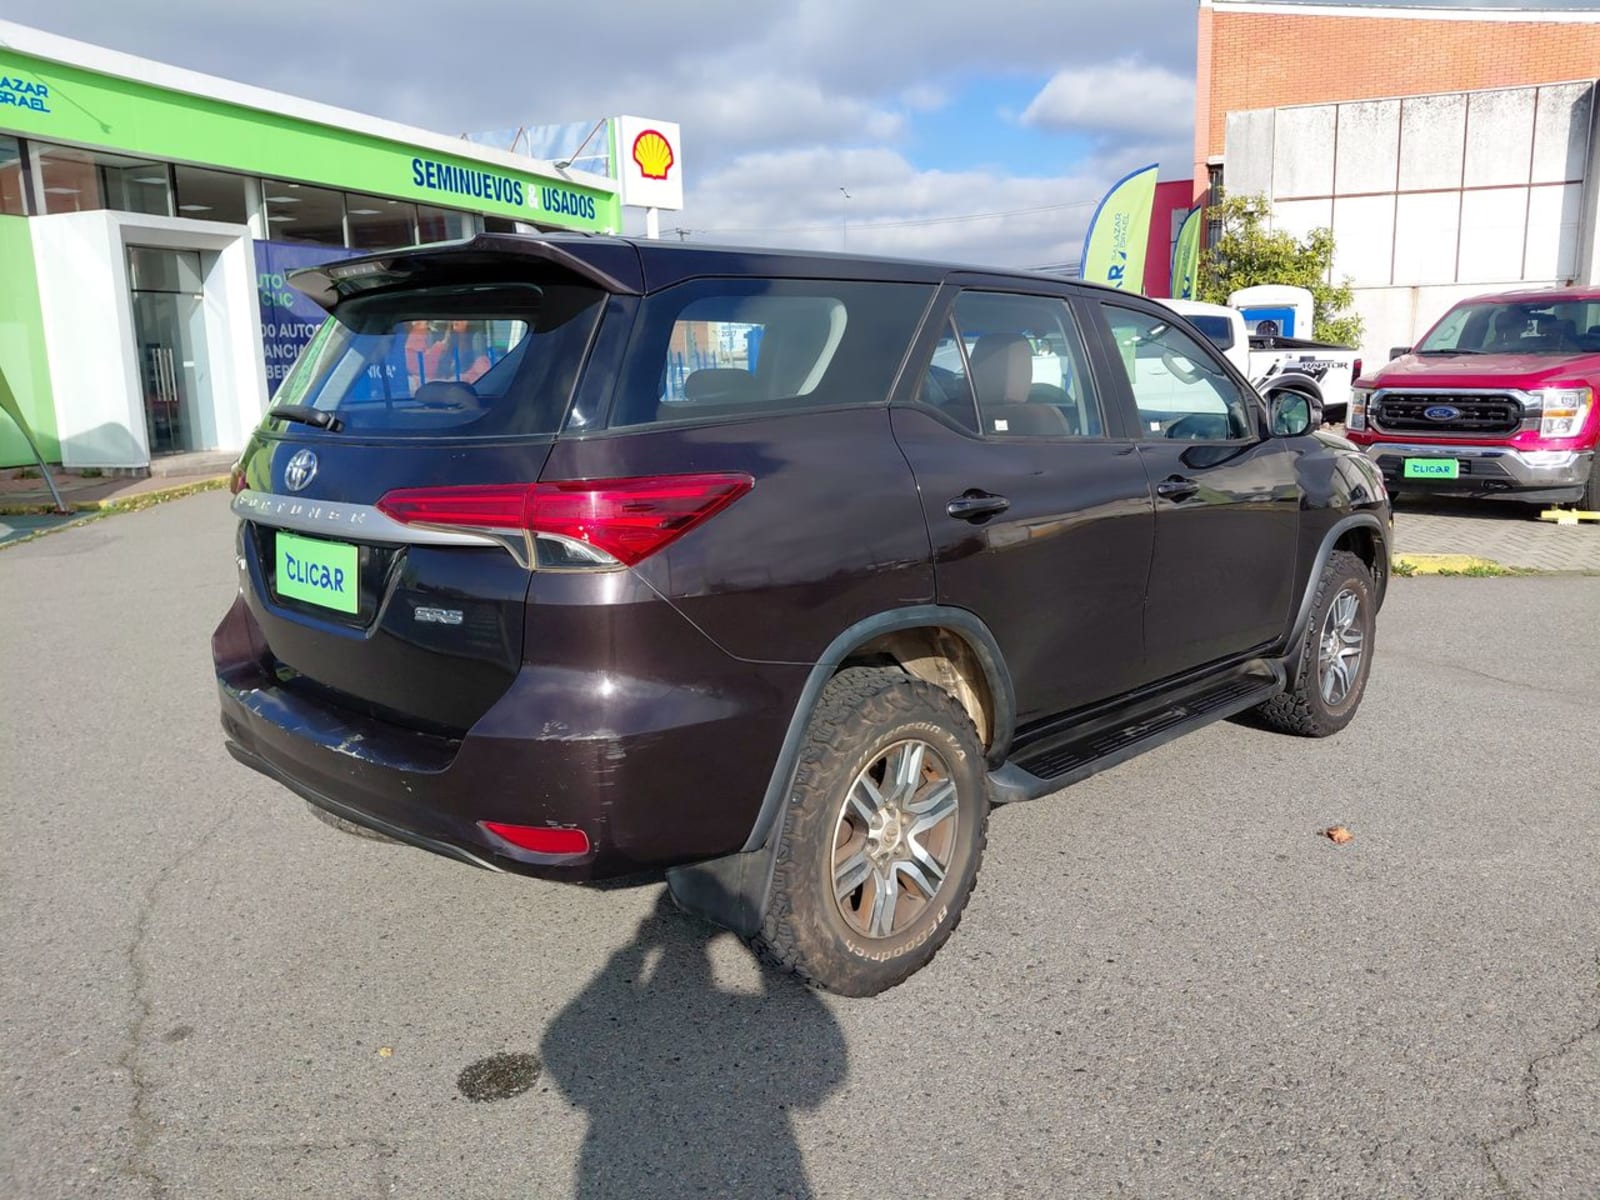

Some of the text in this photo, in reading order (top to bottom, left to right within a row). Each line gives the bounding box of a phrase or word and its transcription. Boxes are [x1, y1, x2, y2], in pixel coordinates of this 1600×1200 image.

[0, 76, 48, 98] AZAR
[412, 158, 596, 220] SEMINUEVOS & USADOS
[1302, 360, 1348, 373] RAPTOR
